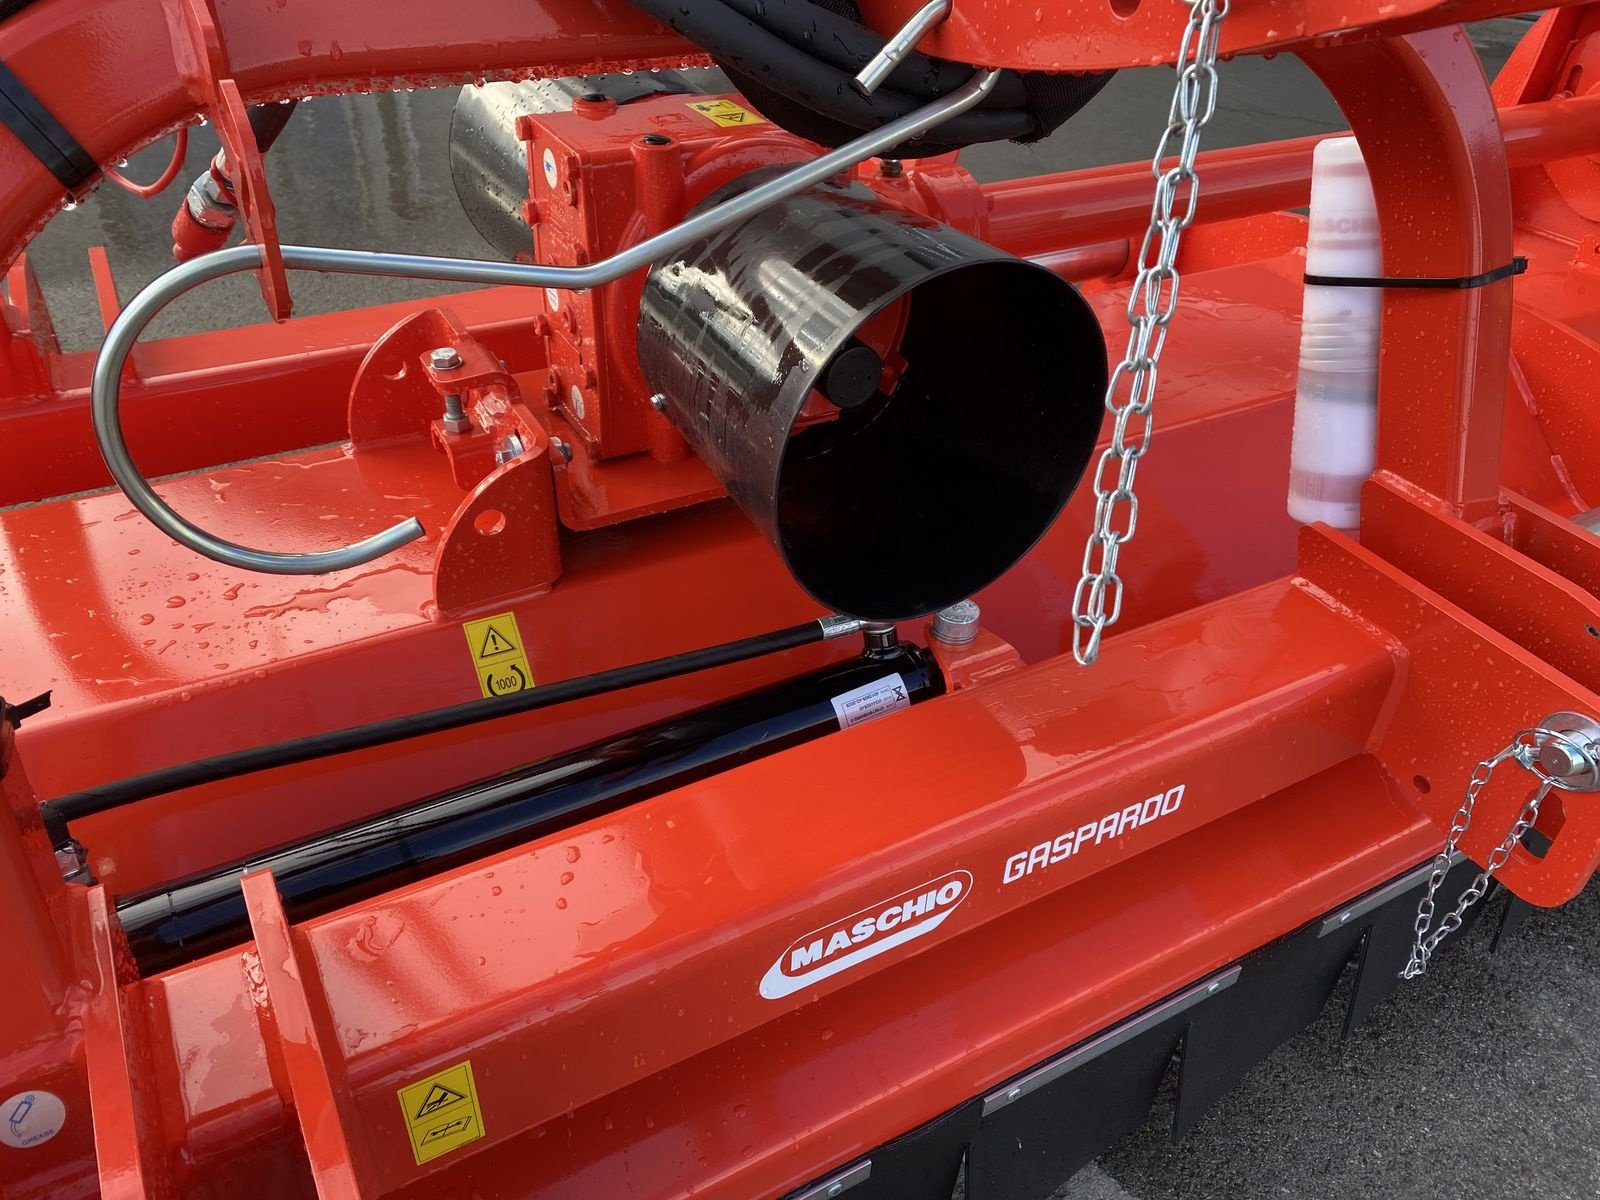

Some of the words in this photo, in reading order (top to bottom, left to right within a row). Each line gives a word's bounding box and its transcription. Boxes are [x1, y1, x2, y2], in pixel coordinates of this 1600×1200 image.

[495, 675, 517, 690] 1000
[790, 880, 963, 972] MASCHIO
[1002, 783, 1186, 885] GASPARDO
[21, 1128, 55, 1146] GREASE
